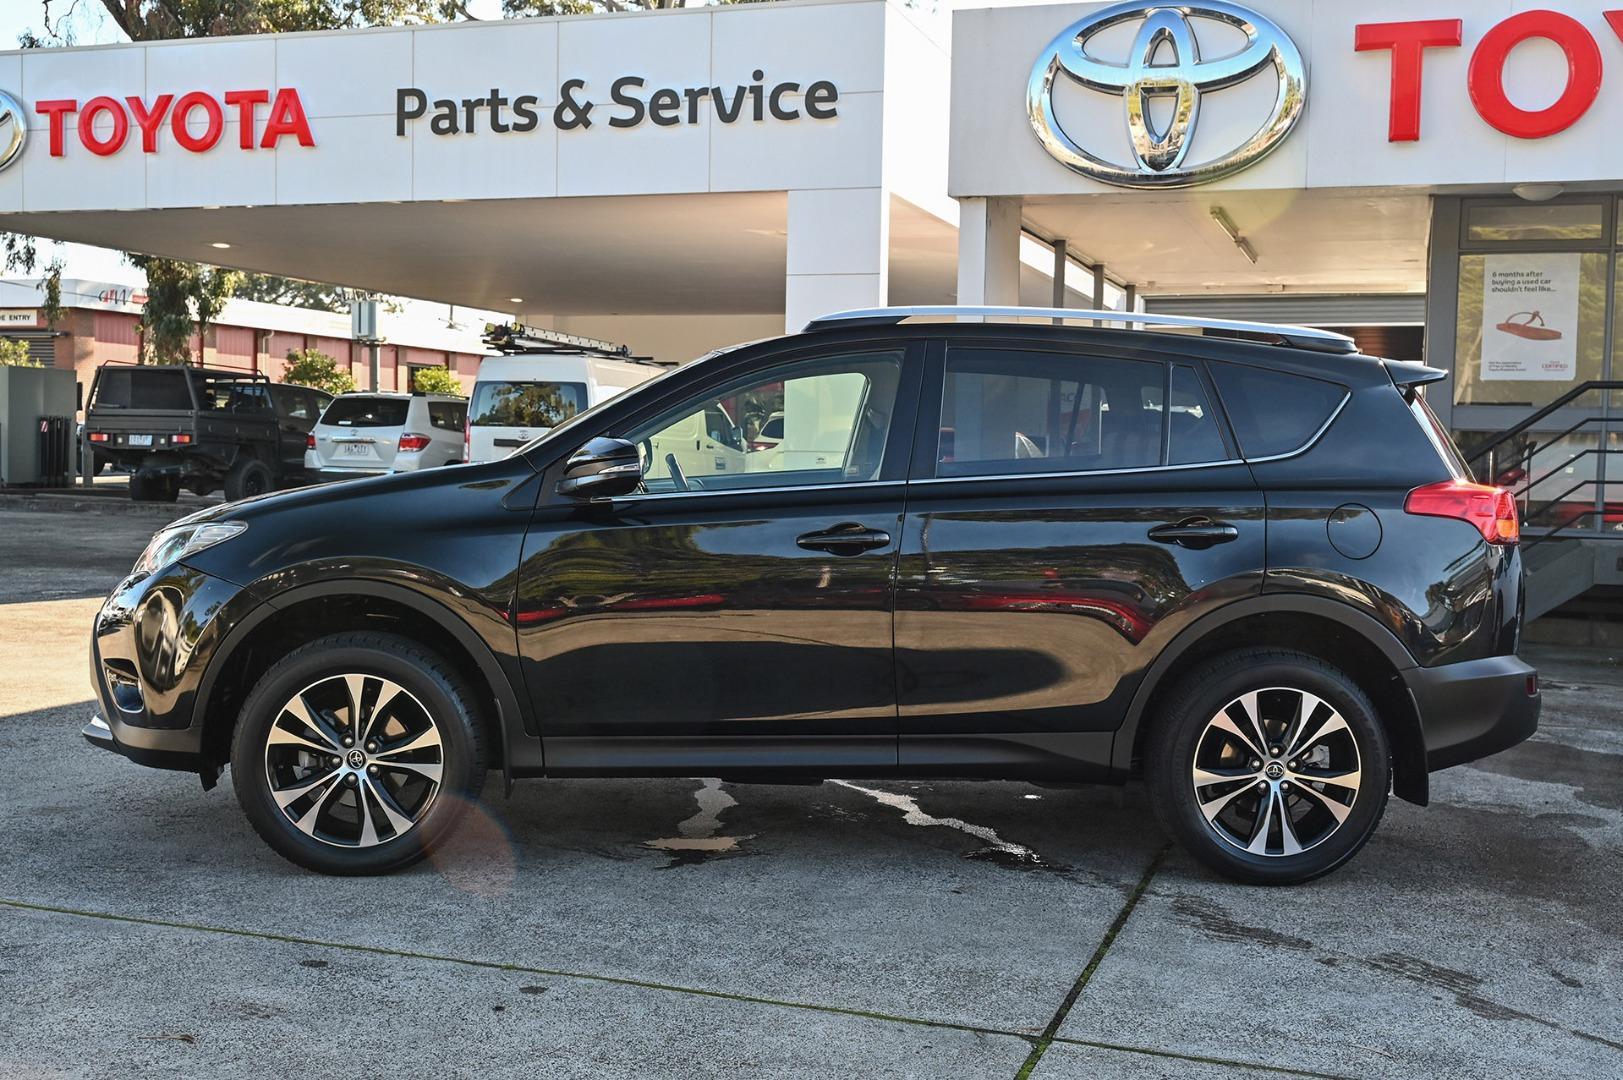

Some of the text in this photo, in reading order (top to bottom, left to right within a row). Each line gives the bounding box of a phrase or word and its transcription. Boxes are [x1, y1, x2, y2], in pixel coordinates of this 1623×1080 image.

[396, 69, 839, 136] Parts & Service
[1354, 9, 1623, 142] TO
[35, 87, 316, 157] TOYOTA
